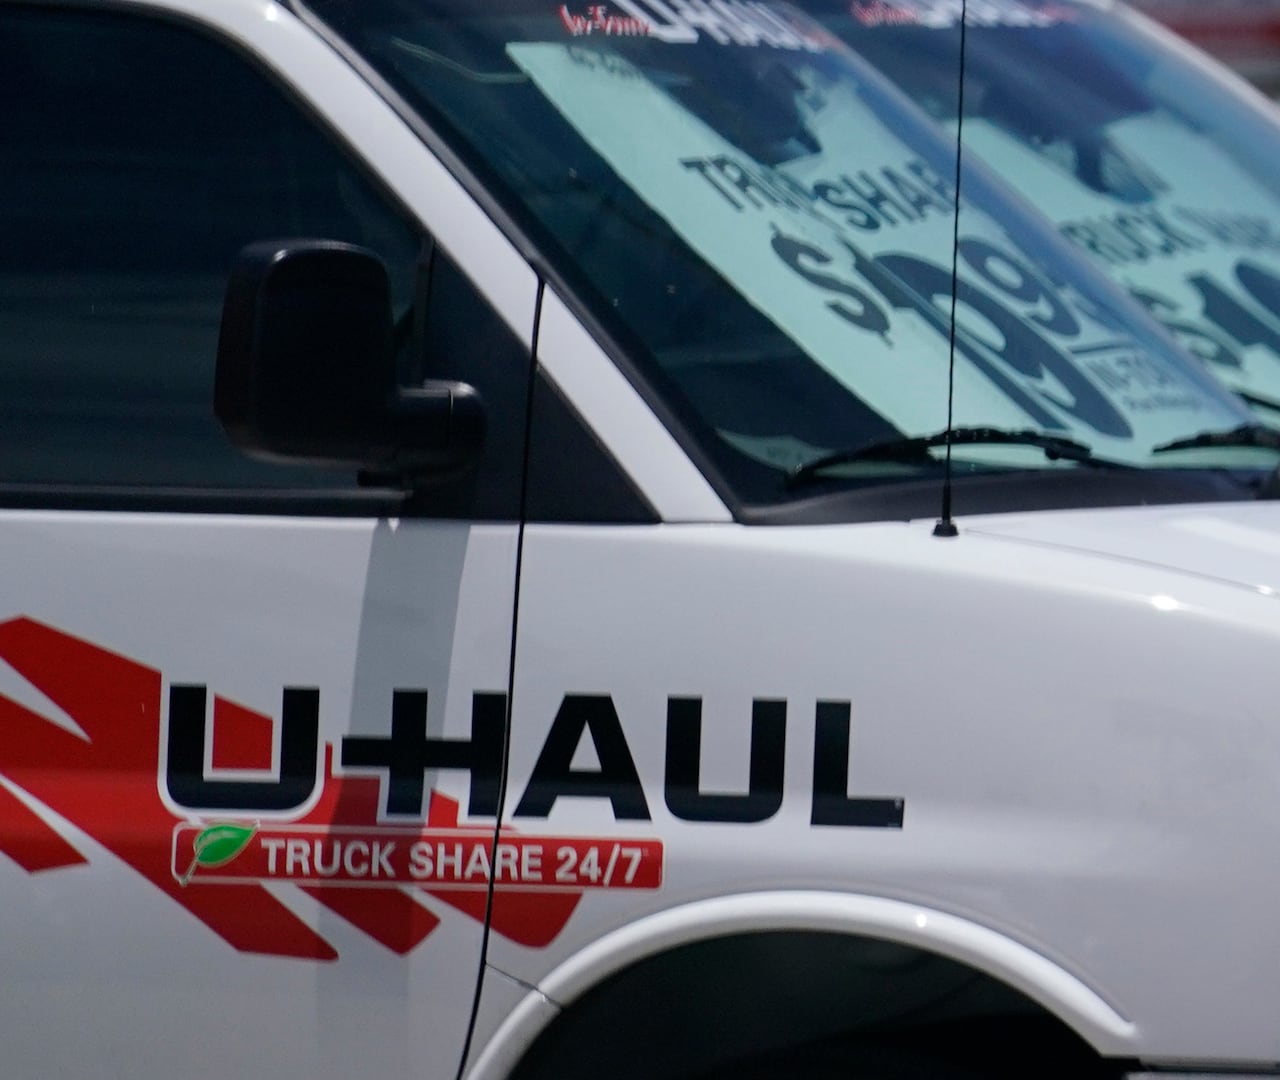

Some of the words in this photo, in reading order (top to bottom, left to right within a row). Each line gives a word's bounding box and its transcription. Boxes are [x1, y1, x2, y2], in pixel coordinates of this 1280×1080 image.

[262, 837, 401, 878] TRUCK
[408, 842, 543, 882] SHARE
[555, 846, 642, 887] 24/7
